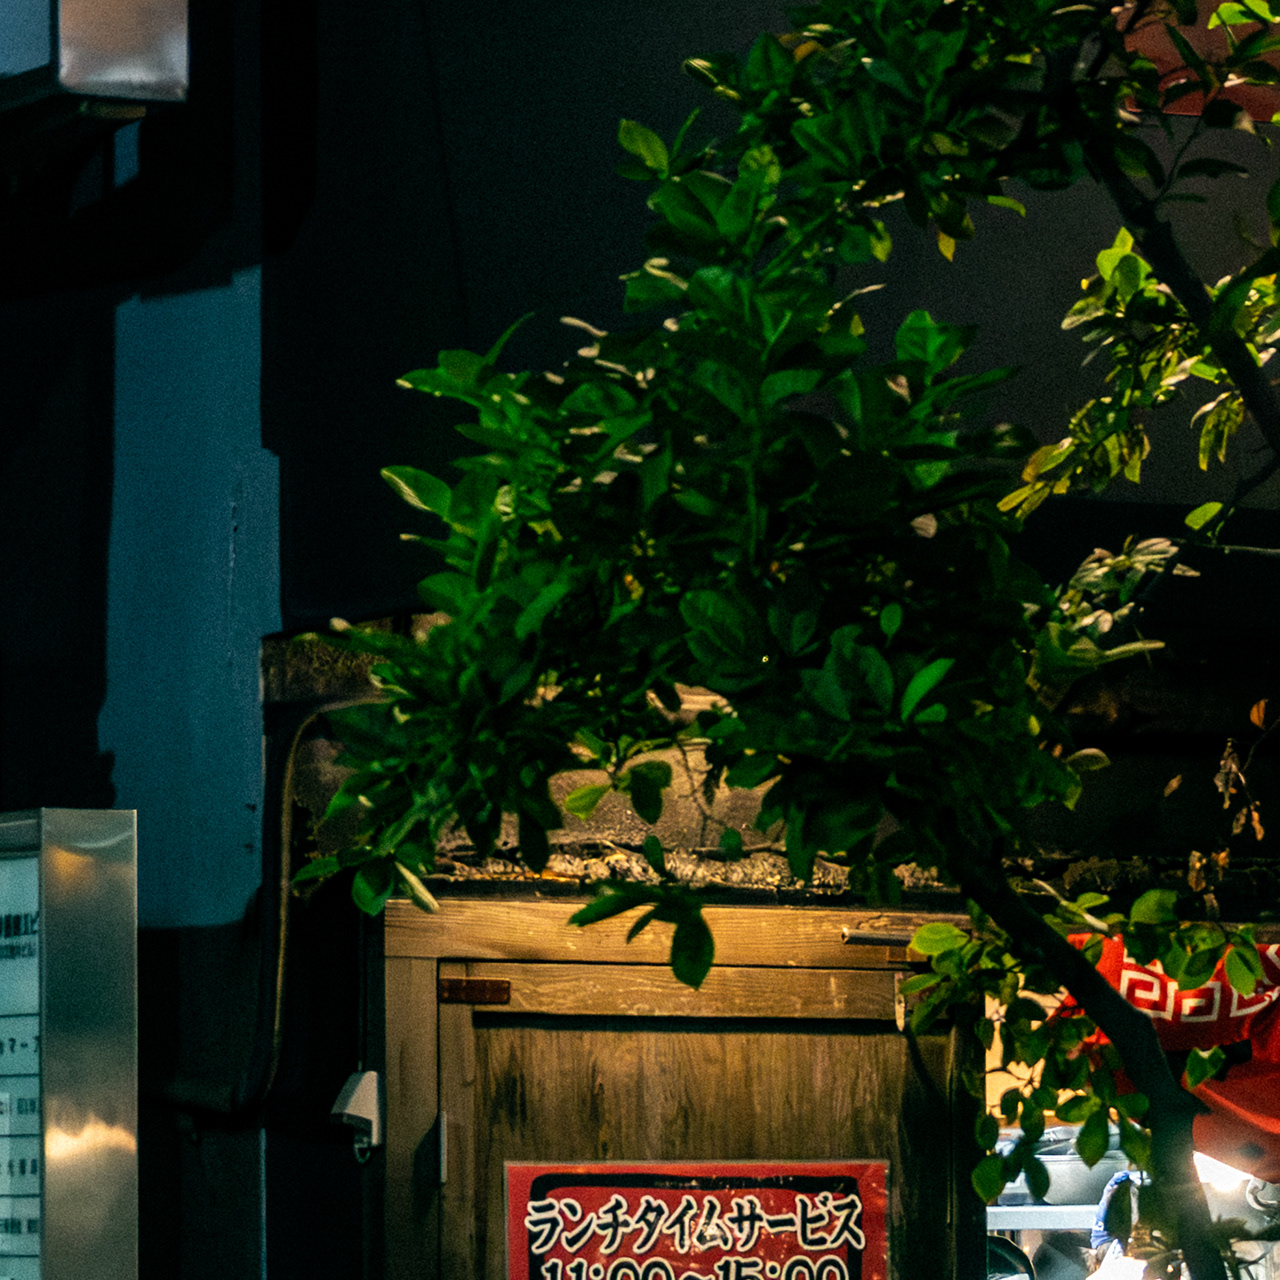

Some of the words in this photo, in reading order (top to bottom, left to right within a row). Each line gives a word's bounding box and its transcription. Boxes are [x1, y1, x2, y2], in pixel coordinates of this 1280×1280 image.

[524, 1191, 866, 1255] ランチタイムサービス
